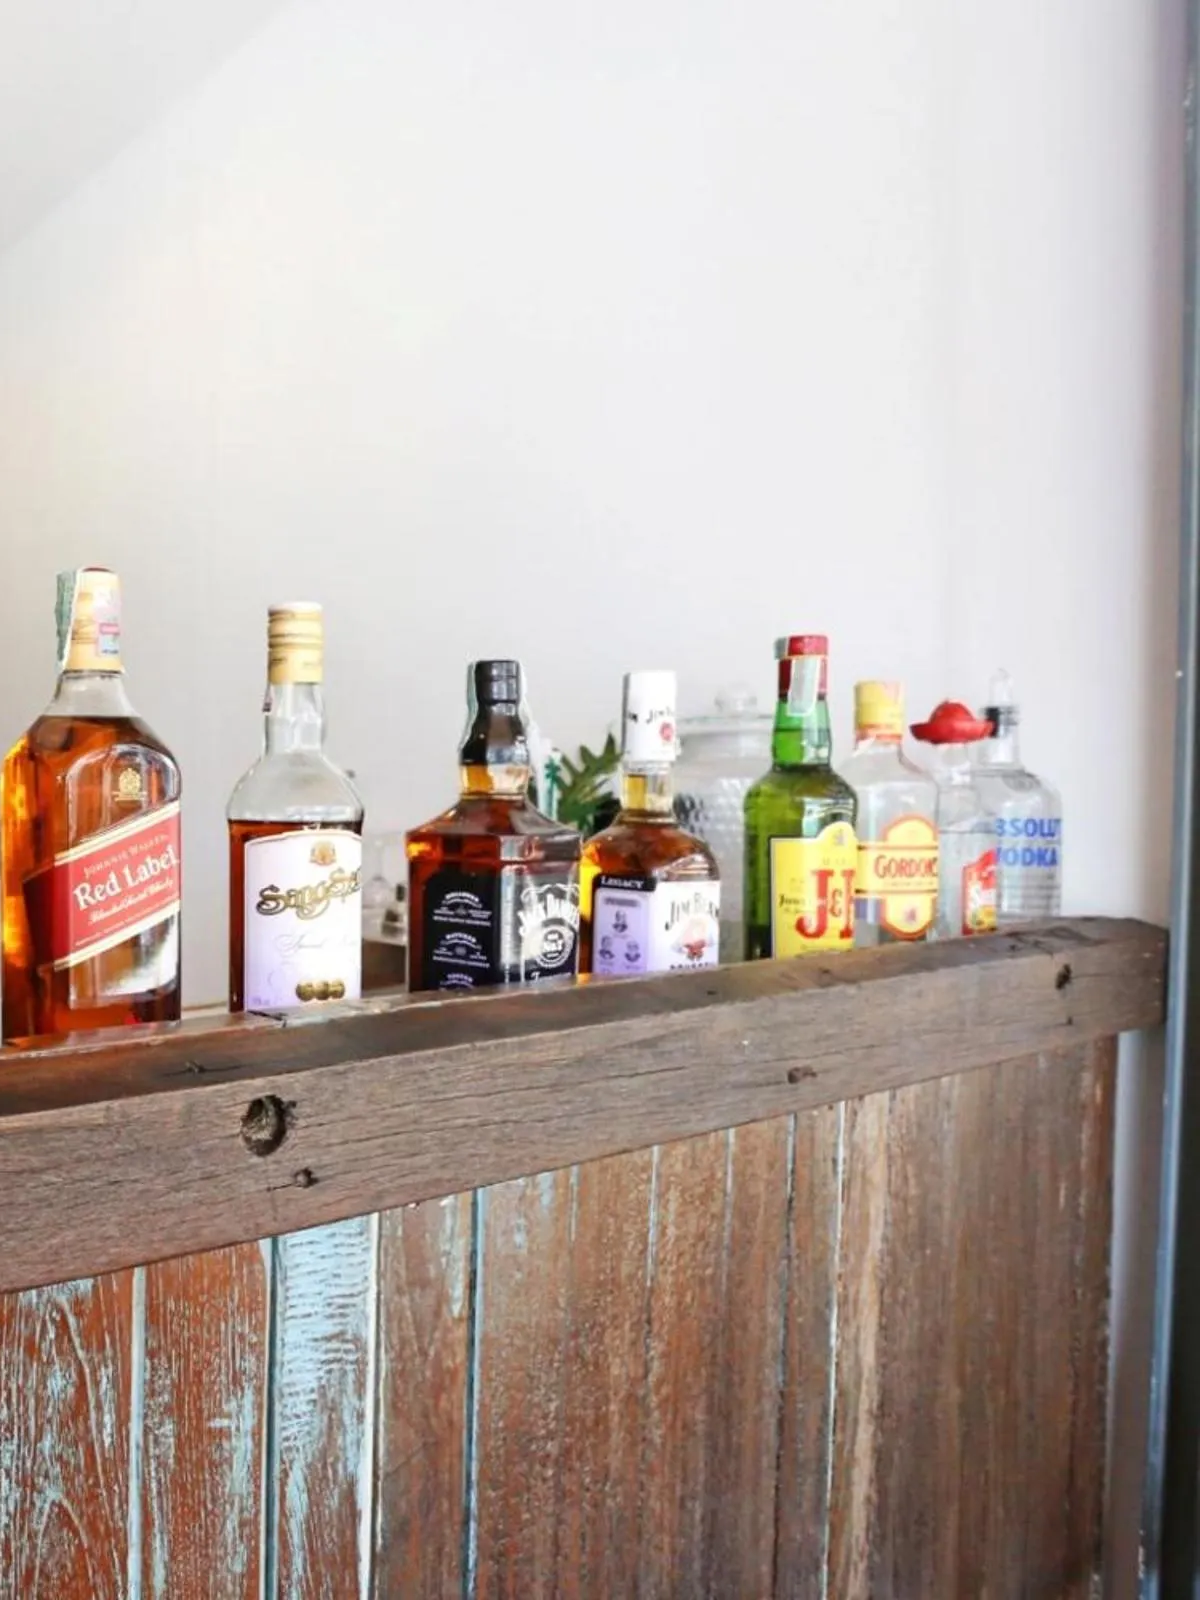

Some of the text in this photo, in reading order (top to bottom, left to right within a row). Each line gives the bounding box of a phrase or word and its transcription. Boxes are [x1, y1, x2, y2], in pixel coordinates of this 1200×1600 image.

[72, 871, 122, 911] Red
[121, 844, 180, 888] Label
[601, 876, 645, 889] LEGACY
